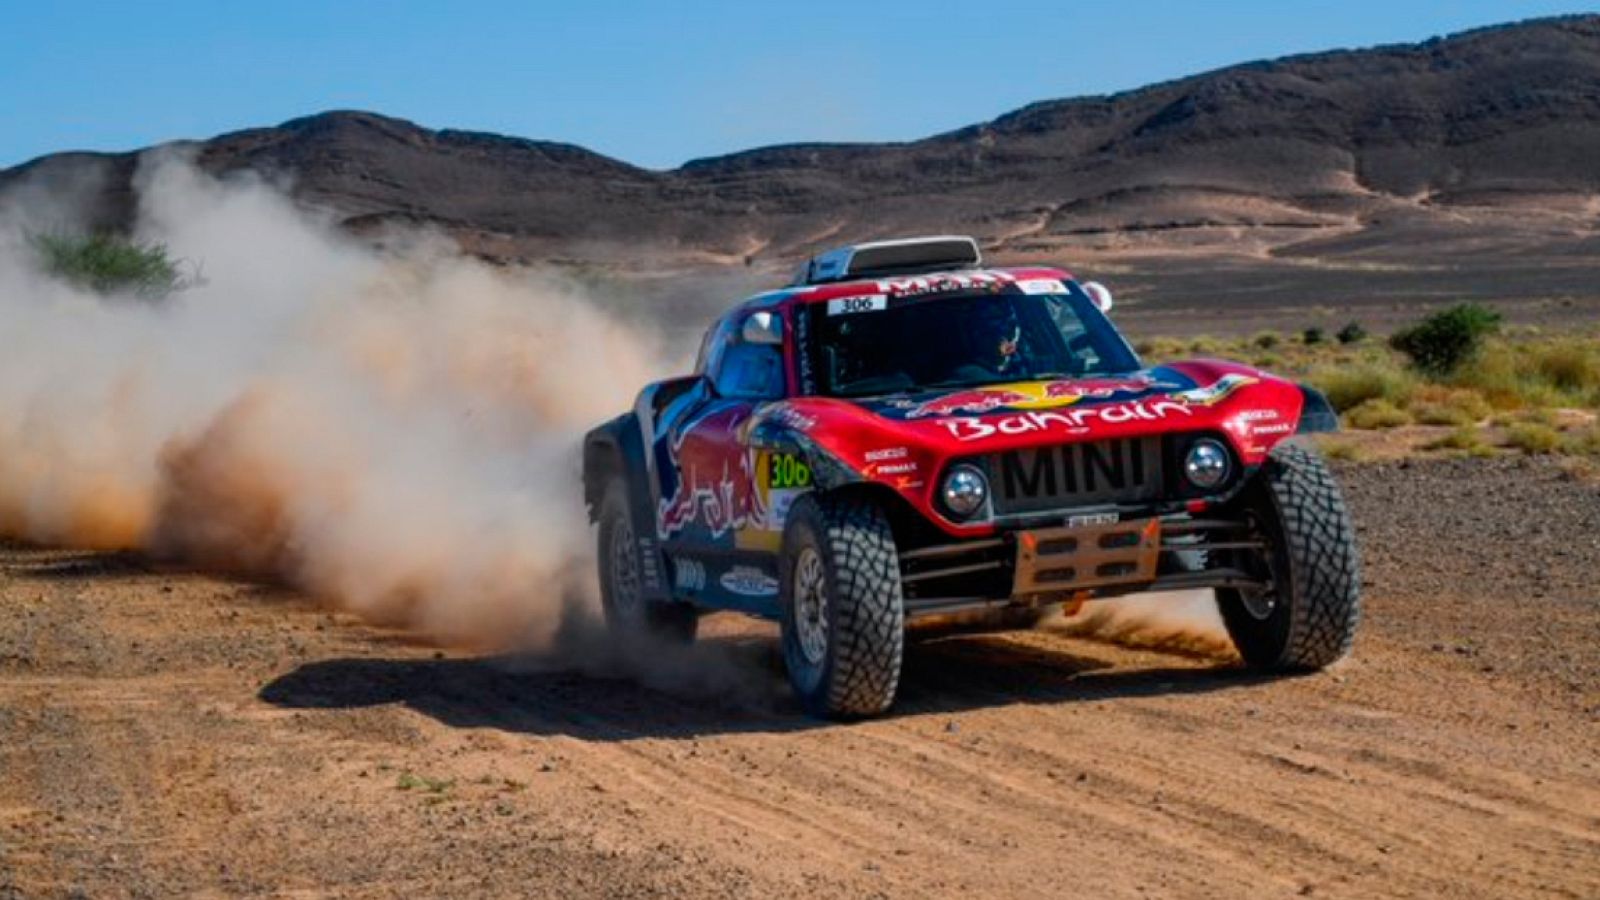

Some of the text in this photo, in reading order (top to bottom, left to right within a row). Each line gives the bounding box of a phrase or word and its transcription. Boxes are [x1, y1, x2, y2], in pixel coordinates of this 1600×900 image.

[841, 297, 873, 312] 306
[936, 399, 1193, 441] Bahrain
[772, 453, 810, 488] 306
[877, 462, 917, 474] PRIMAX
[1002, 439, 1145, 499] MINI
